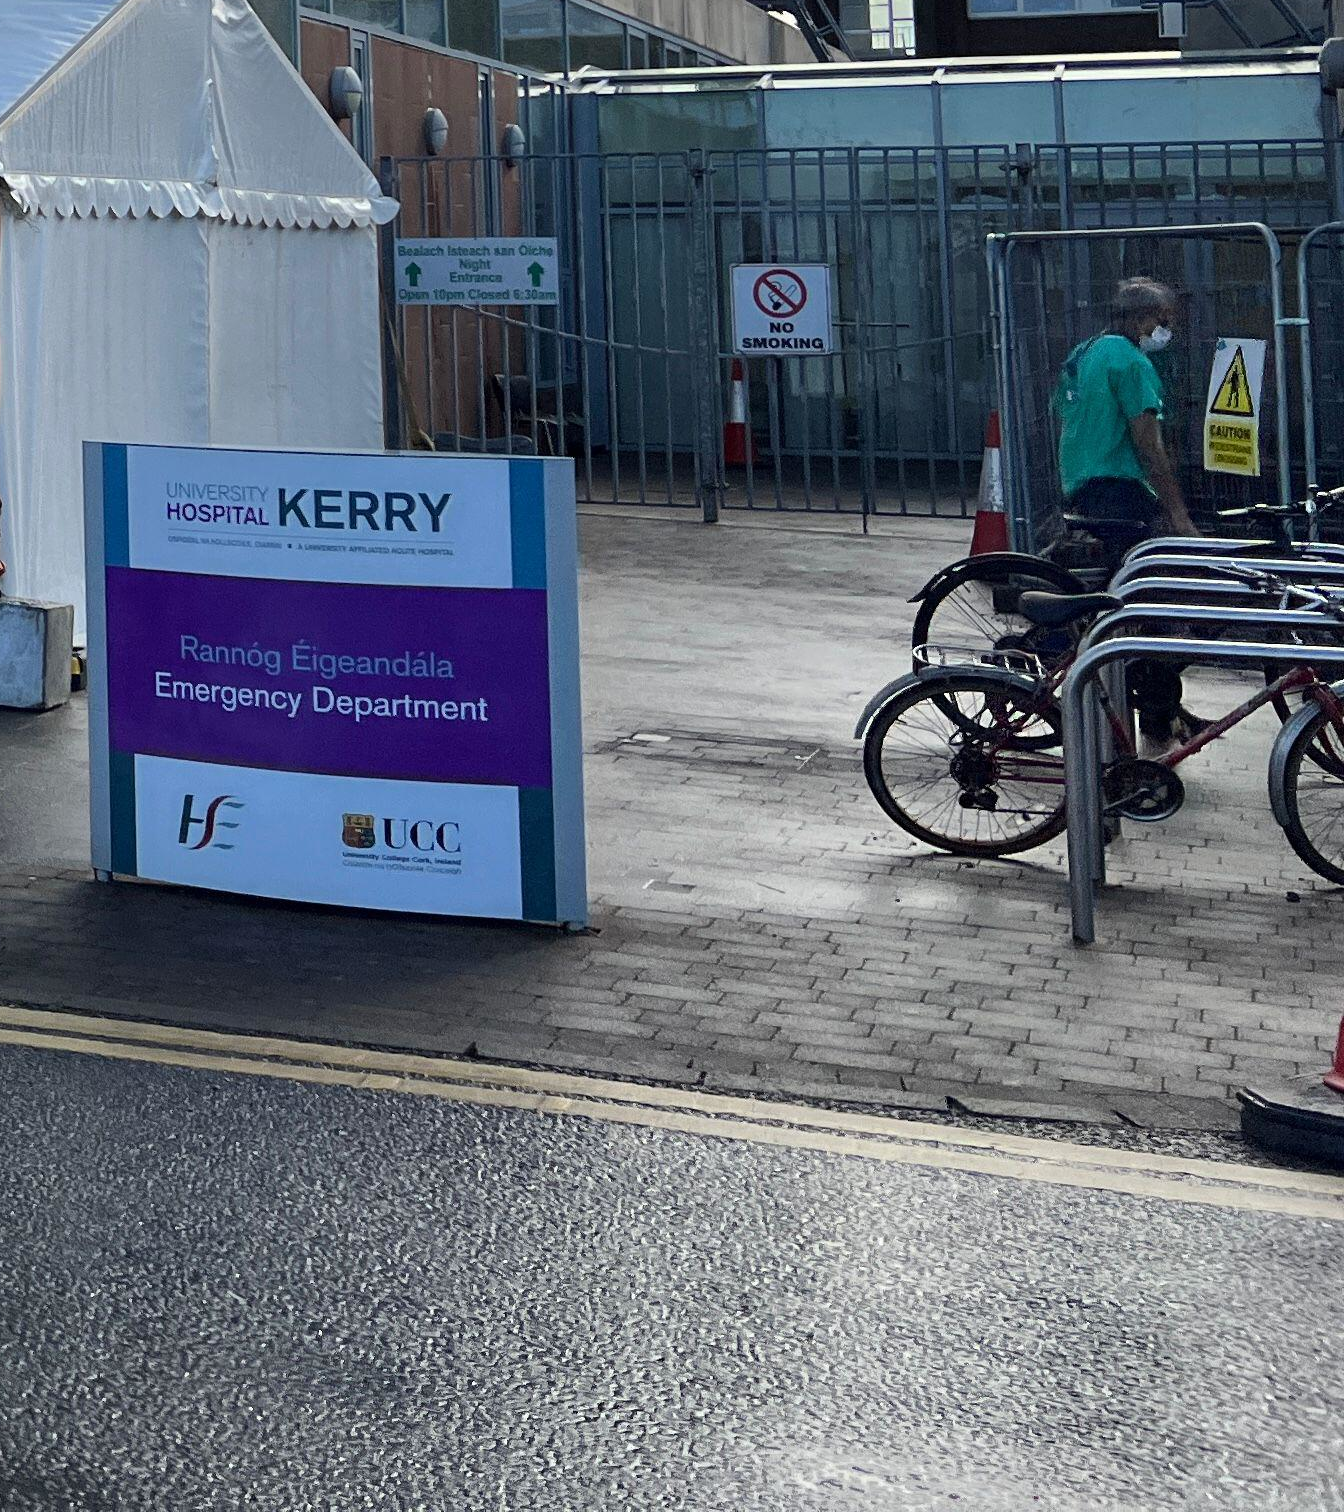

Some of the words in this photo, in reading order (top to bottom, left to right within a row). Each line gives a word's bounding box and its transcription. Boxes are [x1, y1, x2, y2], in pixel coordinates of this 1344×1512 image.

[398, 245, 444, 257] Bealach
[447, 244, 491, 257] Isteach
[494, 246, 515, 256] san
[459, 258, 491, 272] Night
[449, 272, 503, 283] Entrance
[398, 289, 429, 301] Open
[433, 289, 465, 301] 10pm
[468, 289, 510, 300] Closed
[769, 322, 794, 333] NO
[742, 337, 824, 349] SMOKING
[1209, 424, 1251, 440] CAUTION
[166, 481, 269, 502] UNIVERSITY
[166, 501, 270, 526] HOSPITAL
[278, 488, 453, 533] KERRY
[180, 635, 282, 675] Rannóg
[291, 639, 455, 679] Éigeandála
[155, 671, 302, 718] Emergency
[312, 686, 489, 722] Department
[382, 818, 461, 853] UCC
